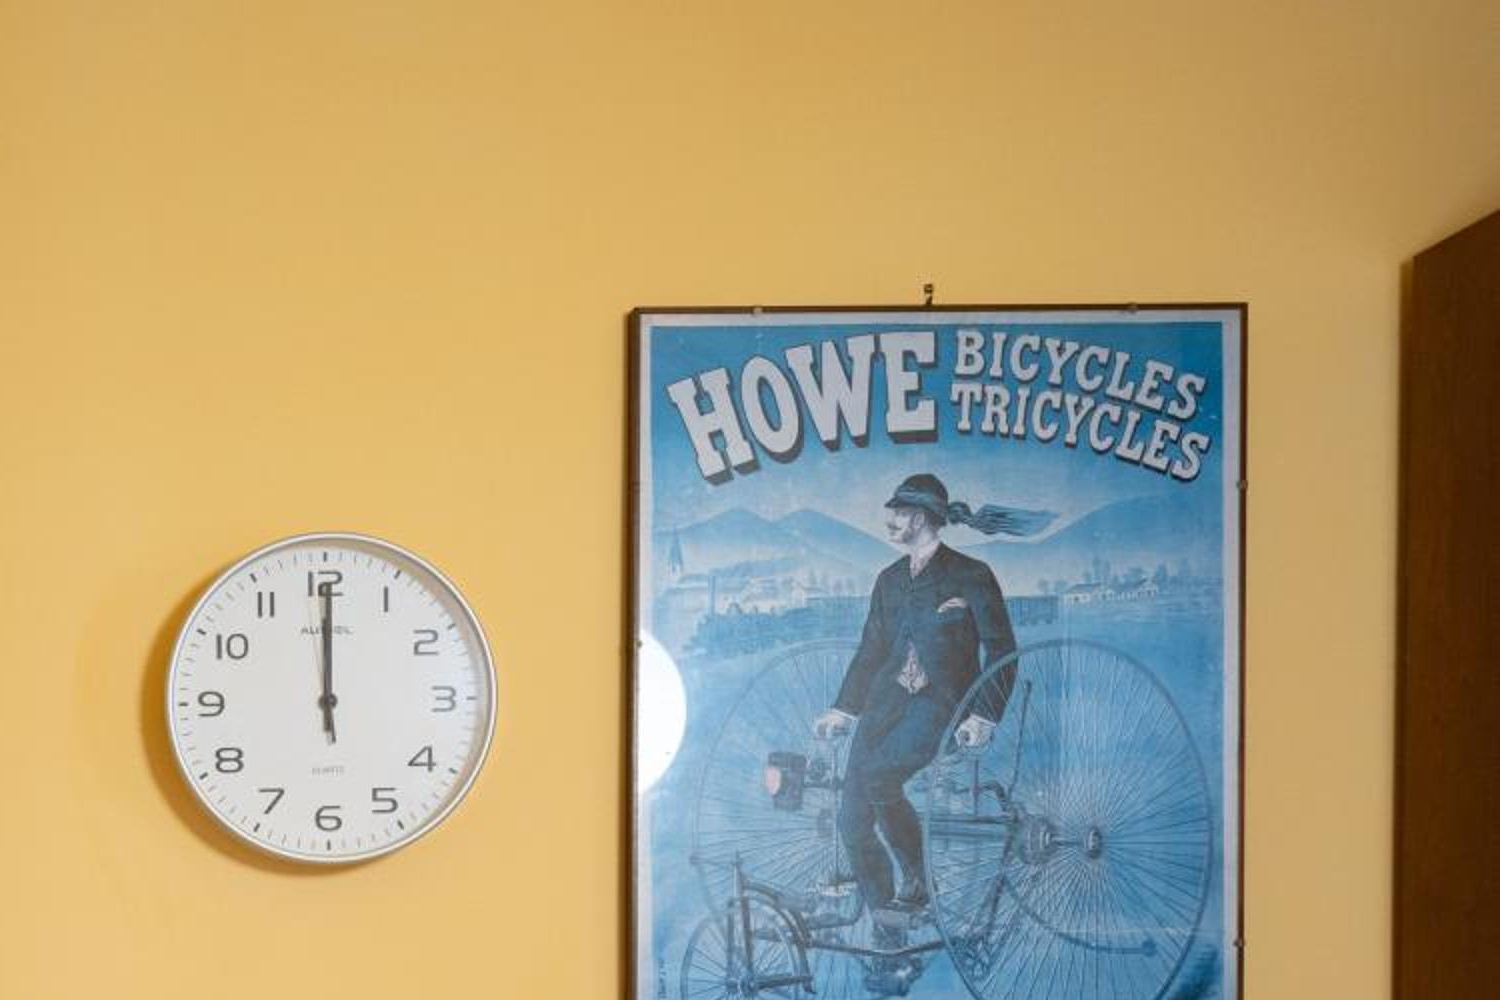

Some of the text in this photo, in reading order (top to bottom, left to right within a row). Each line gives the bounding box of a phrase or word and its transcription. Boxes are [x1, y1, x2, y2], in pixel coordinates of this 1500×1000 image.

[952, 328, 1206, 420] BICYCLES
[666, 330, 939, 485] HOWE
[950, 381, 1212, 482] TRICYCLES
[307, 570, 344, 597] 12
[257, 591, 275, 618] 11
[216, 633, 250, 660] 10
[413, 629, 439, 656] 2
[197, 691, 226, 717] 9
[431, 685, 457, 713] 3
[214, 747, 244, 774] 8
[407, 746, 437, 773] 4
[258, 787, 286, 814] 7
[371, 787, 398, 813] 5
[315, 805, 343, 832] 6
